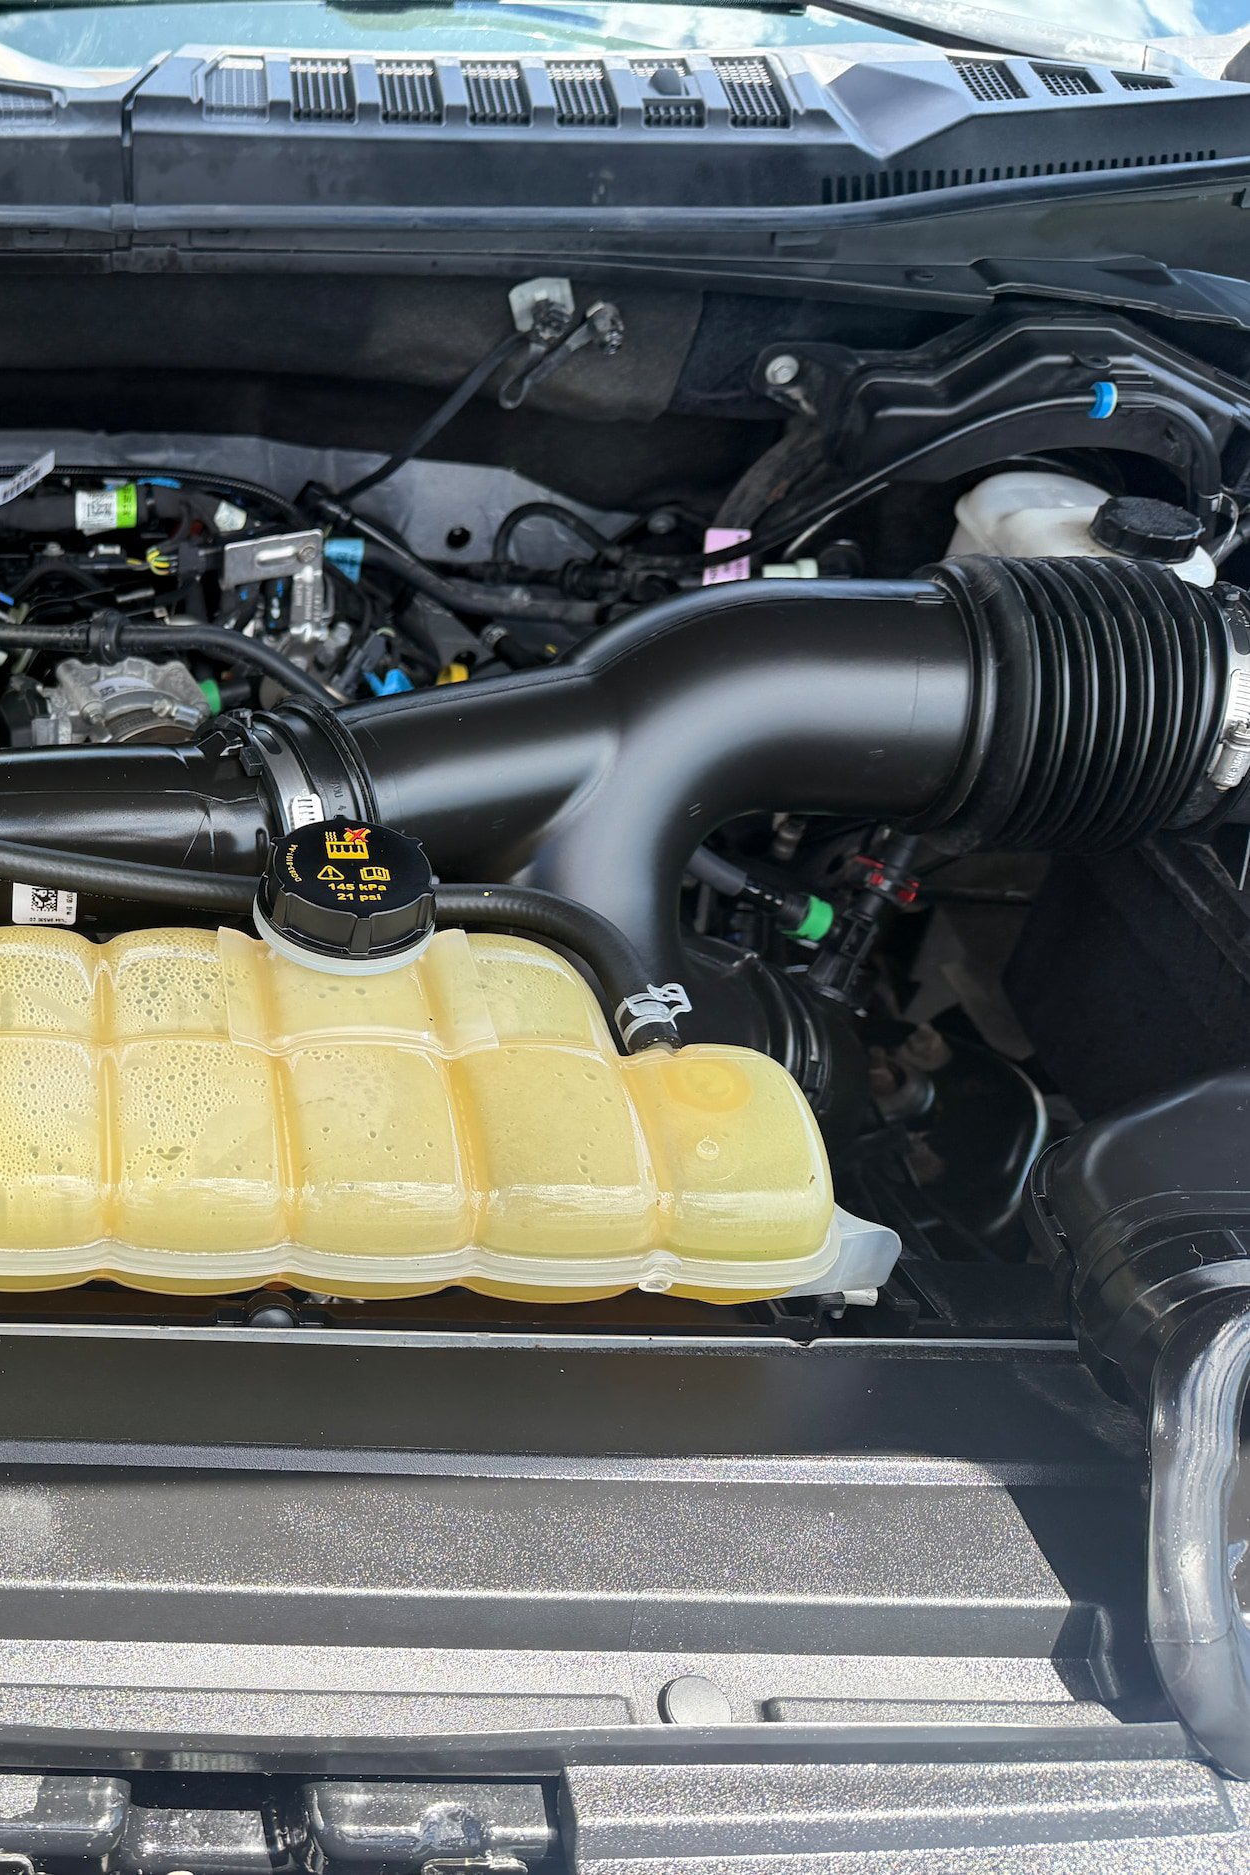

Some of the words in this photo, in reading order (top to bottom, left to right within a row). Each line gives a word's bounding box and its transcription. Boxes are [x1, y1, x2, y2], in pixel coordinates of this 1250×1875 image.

[328, 883, 355, 891] 145
[359, 883, 387, 892] kPa
[337, 893, 354, 901] 21
[359, 893, 382, 902] psi
